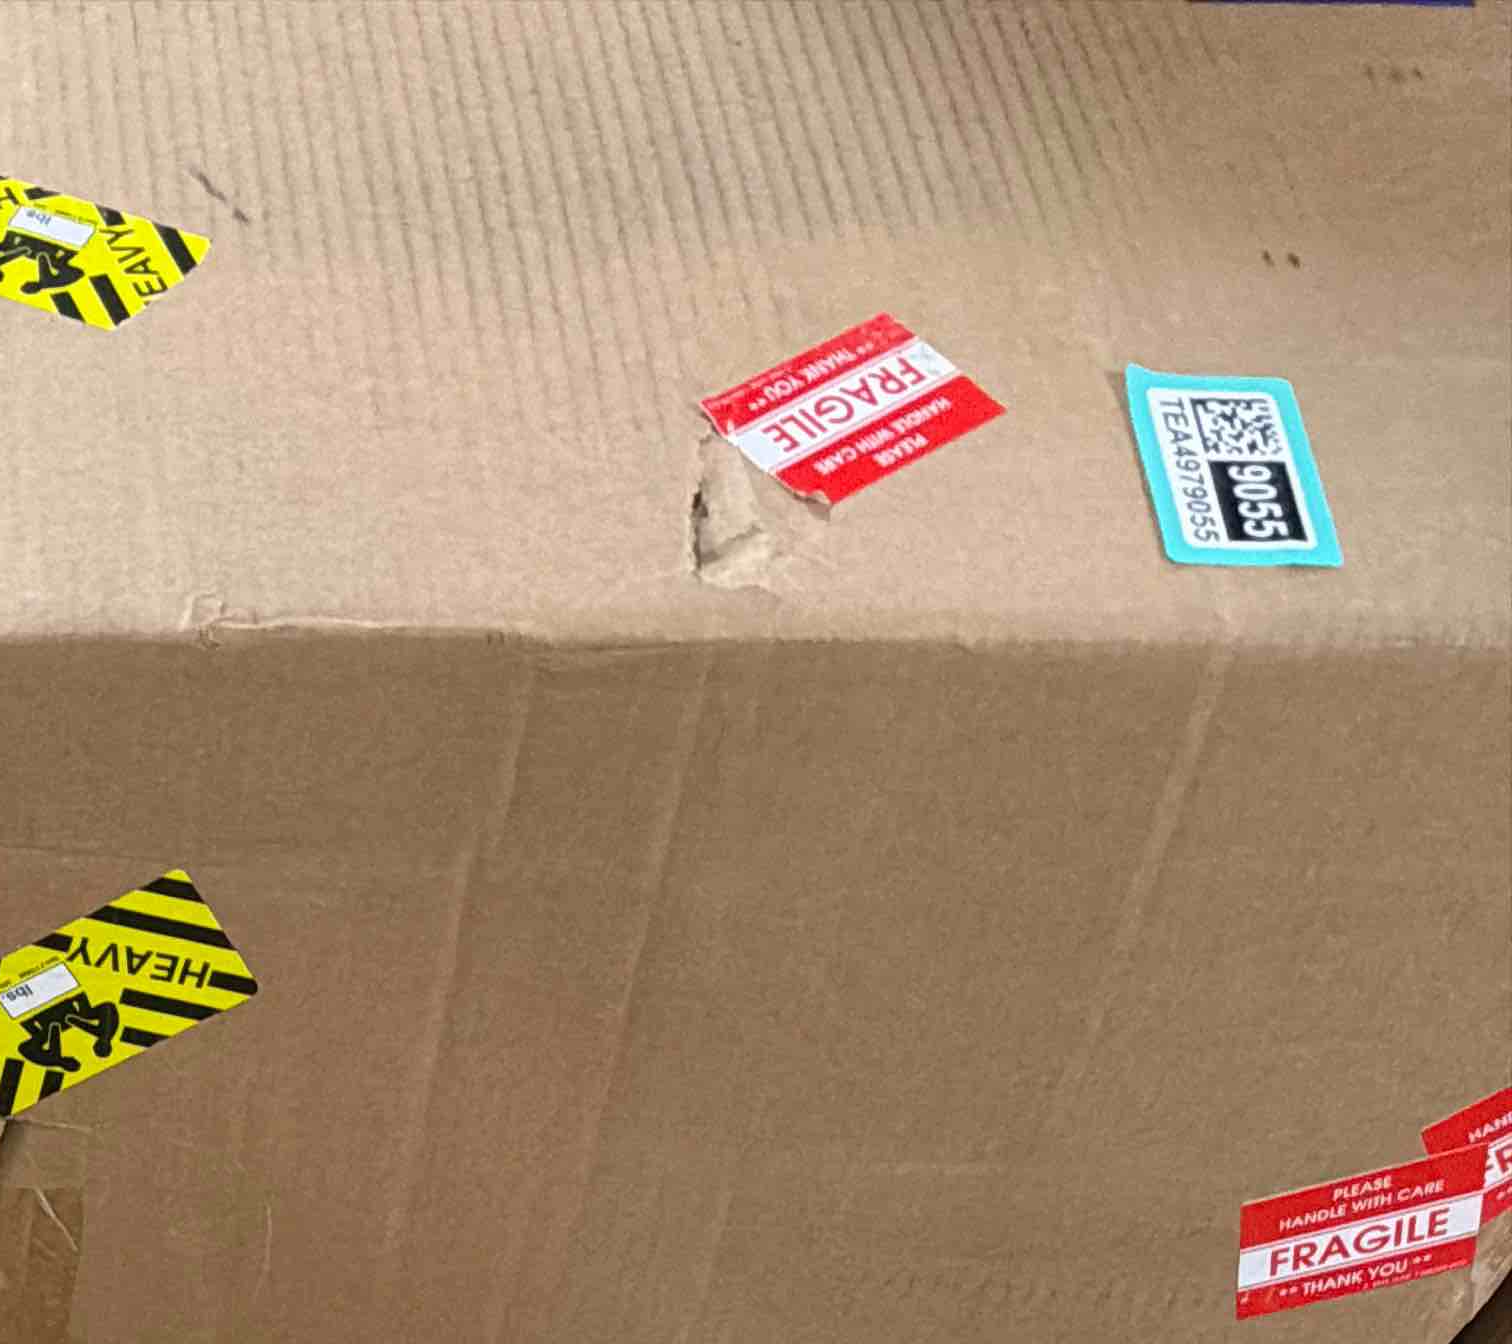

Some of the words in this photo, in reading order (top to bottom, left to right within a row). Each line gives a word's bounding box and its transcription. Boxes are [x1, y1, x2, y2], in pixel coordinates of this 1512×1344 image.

[98, 228, 169, 303] EAVY
[762, 357, 926, 453] FRAGILE
[1159, 397, 1220, 542] TEA4979055
[1227, 464, 1289, 538] 9055
[66, 936, 211, 989] HEAVY
[1279, 1205, 1346, 1232] HANDLE
[1352, 1192, 1393, 1214] WITH
[1397, 1179, 1445, 1202] CARE
[1333, 1176, 1392, 1201] PLEASE
[1268, 1206, 1450, 1277] FRAGILE
[1302, 1271, 1364, 1297] THANK
[1368, 1258, 1408, 1285] YOU
